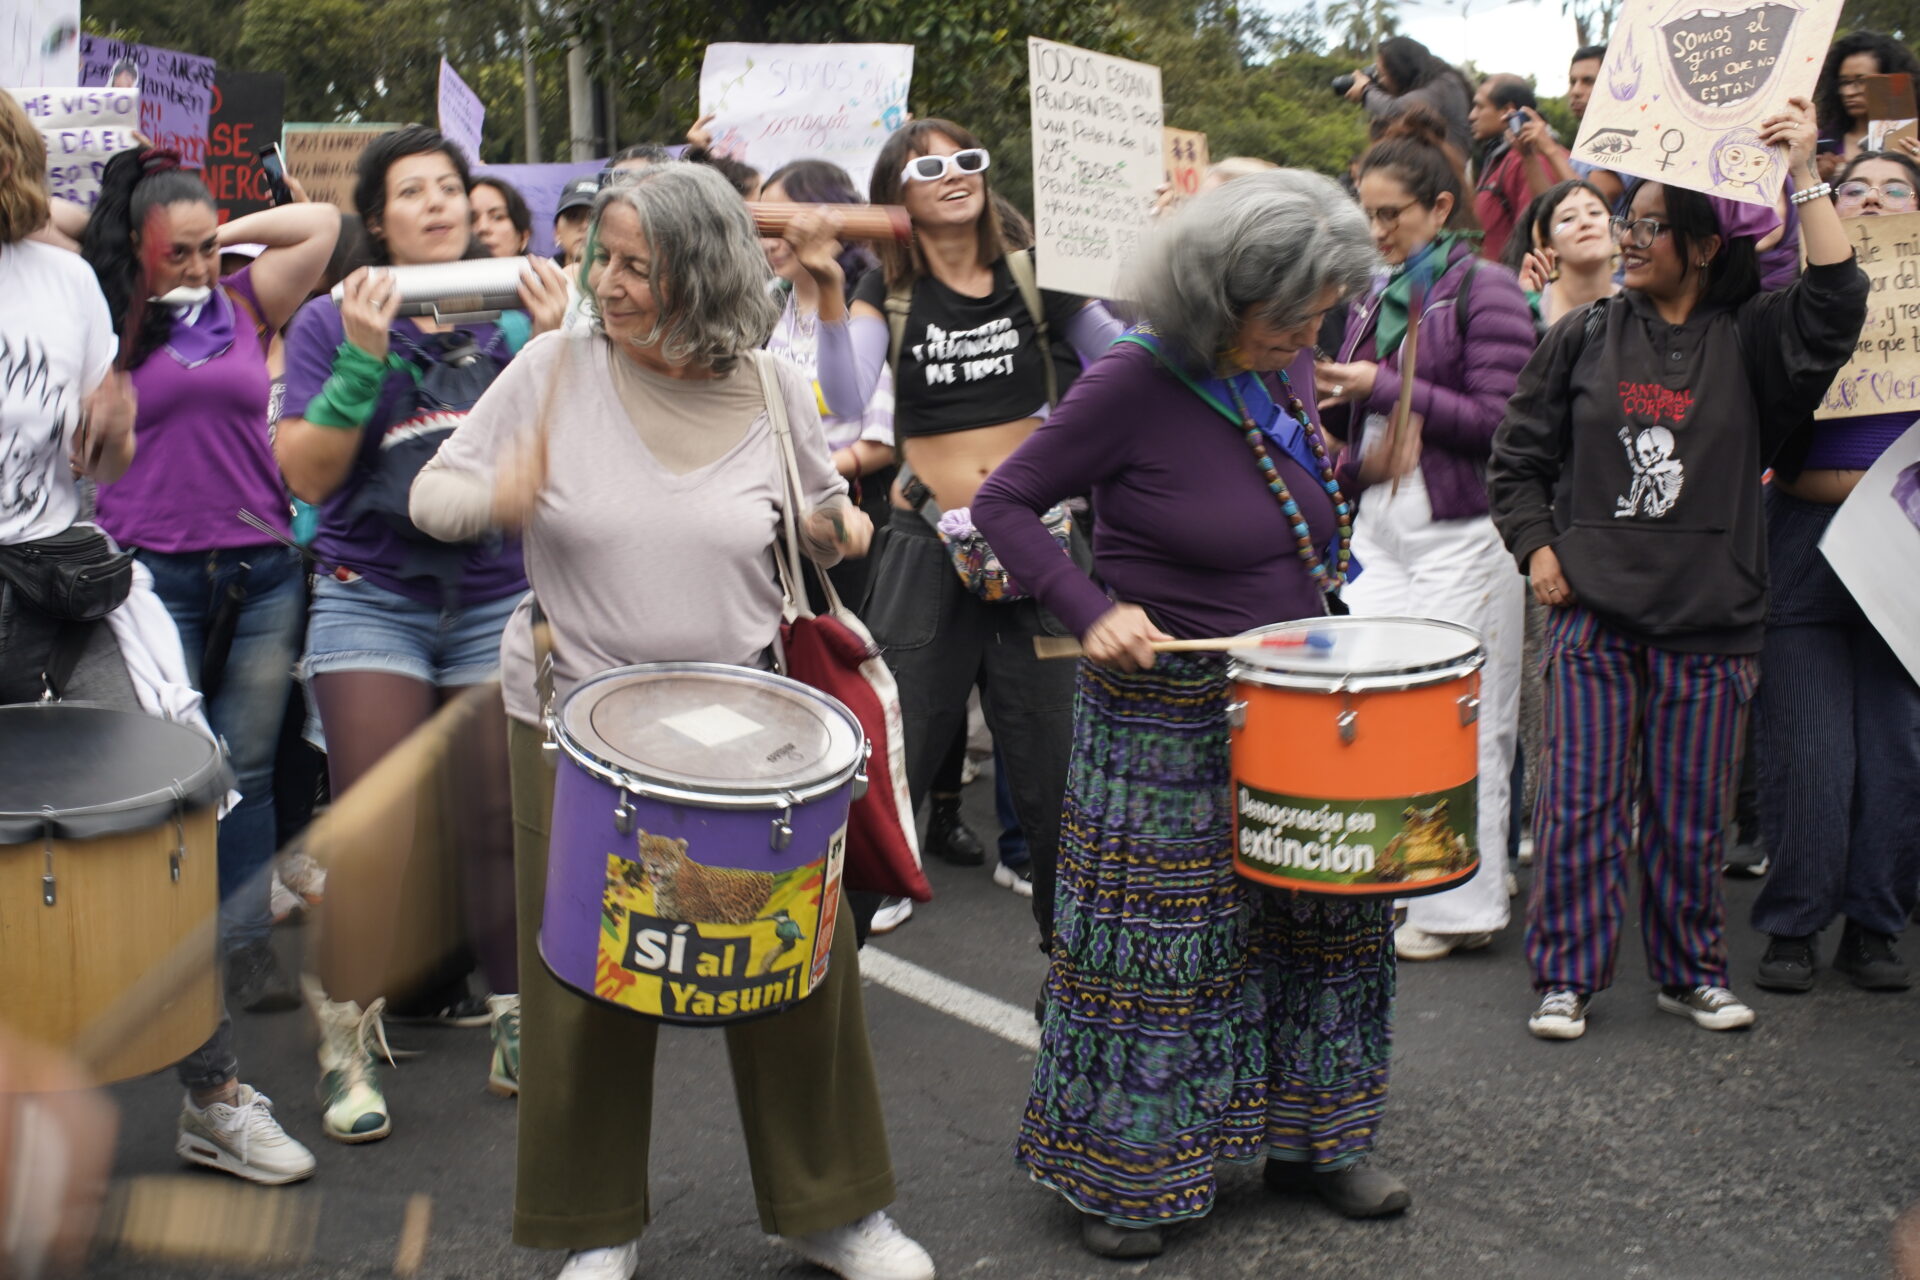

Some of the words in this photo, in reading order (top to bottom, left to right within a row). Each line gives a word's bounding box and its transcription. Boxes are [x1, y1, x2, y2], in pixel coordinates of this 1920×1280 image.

[1745, 11, 1770, 32] el
[1748, 39, 1767, 52] DE
[1032, 43, 1099, 89] TODOS
[61, 92, 132, 114] VISTO
[1346, 812, 1376, 833] en
[1239, 825, 1375, 873] extinción
[696, 944, 736, 978] al
[668, 967, 797, 1015] Yasuní
